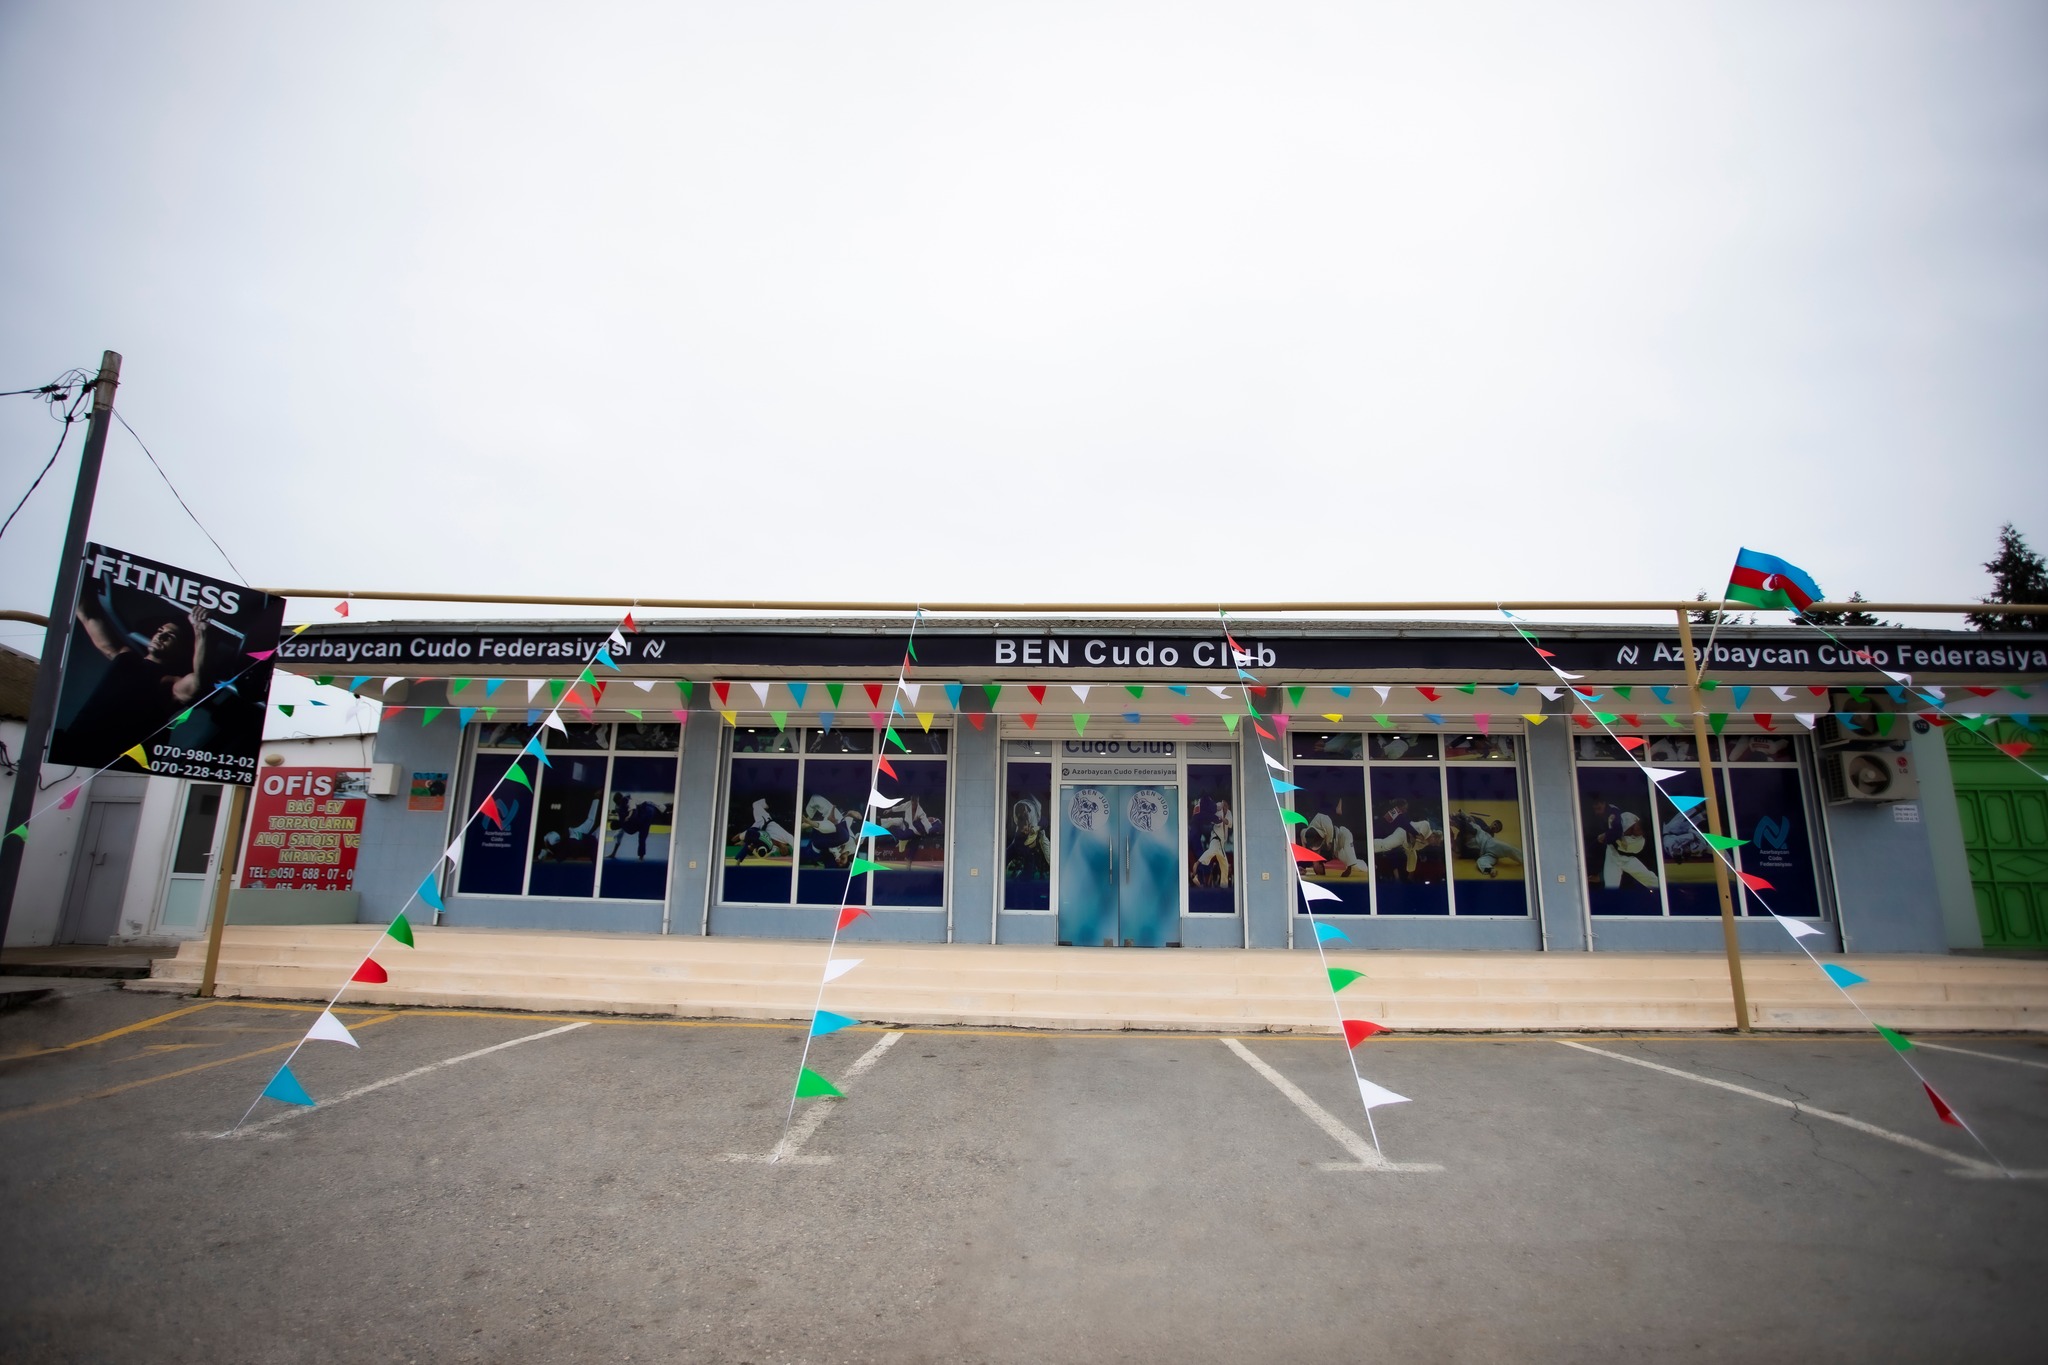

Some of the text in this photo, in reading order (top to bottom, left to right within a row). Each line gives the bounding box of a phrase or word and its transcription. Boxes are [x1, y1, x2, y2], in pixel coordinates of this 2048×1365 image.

[410, 637, 472, 657] Cudo
[995, 639, 1277, 667] BEN Cudo Club
[1818, 644, 1889, 665] Cudo
[153, 744, 255, 769] 070-980-12-02
[1127, 740, 1175, 754] Club
[151, 760, 253, 783] 070-228-43-78
[263, 771, 332, 796] OFİS
[286, 797, 315, 814] BAĞ
[1098, 796, 1110, 815] JUDO
[1157, 796, 1169, 816] JUDO
[269, 816, 357, 832] TORPAQLARIN
[254, 832, 286, 848] ALQI
[288, 833, 341, 849] SATQISI
[279, 846, 341, 864] KİRAYƏSİ
[249, 866, 268, 878] TEL:
[277, 867, 295, 879] 050
[302, 867, 320, 880] 688
[327, 868, 339, 880] 07
